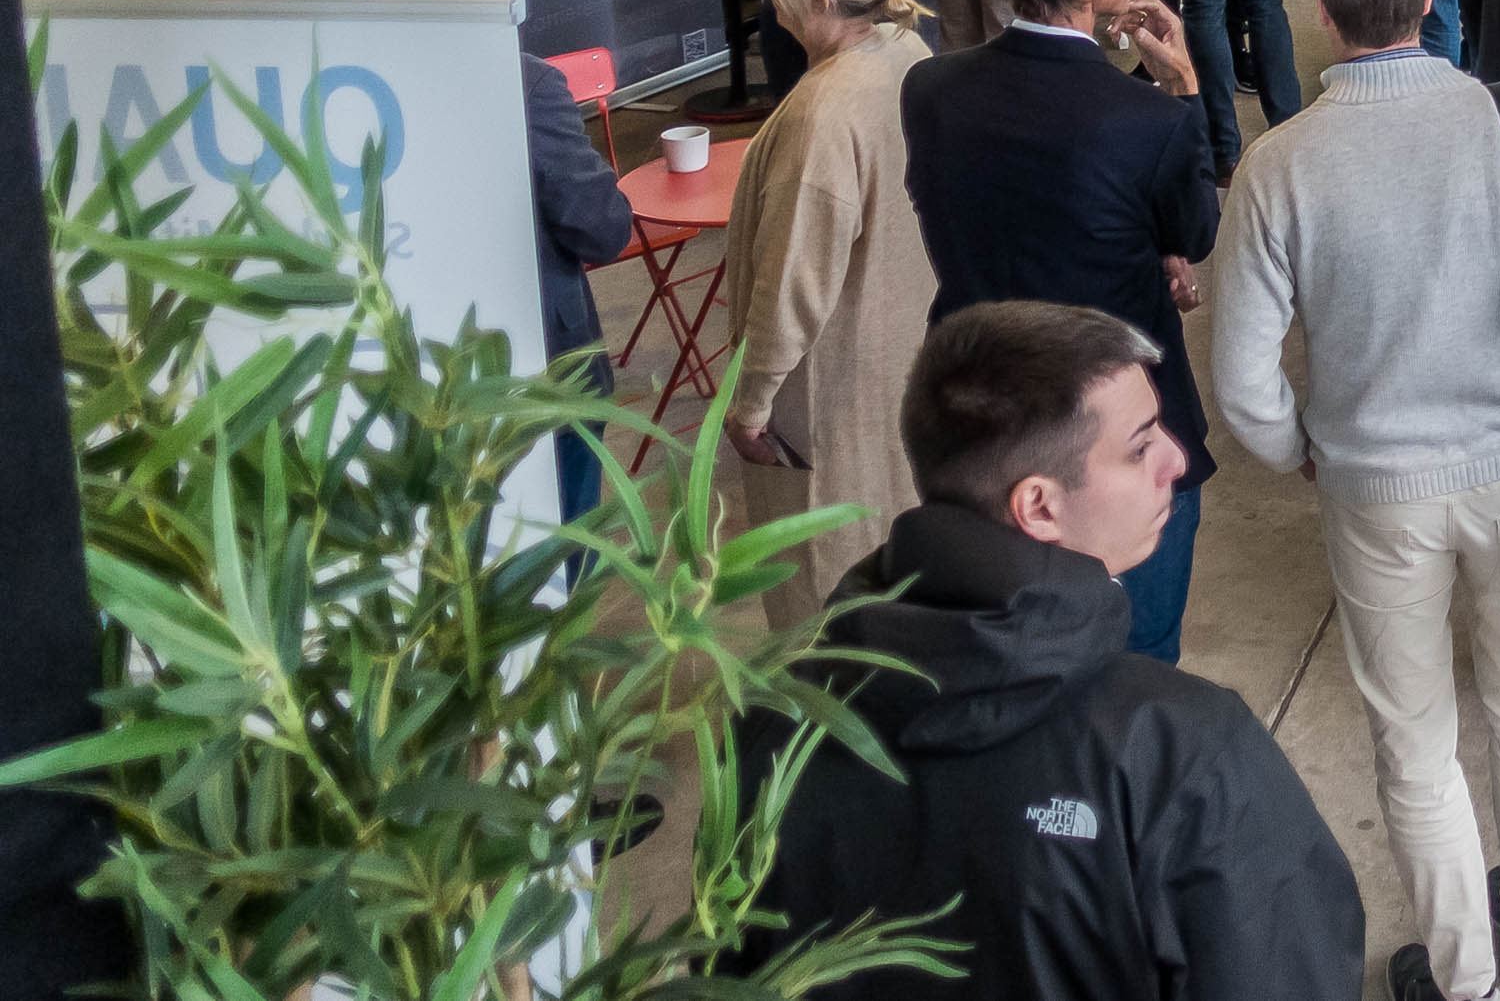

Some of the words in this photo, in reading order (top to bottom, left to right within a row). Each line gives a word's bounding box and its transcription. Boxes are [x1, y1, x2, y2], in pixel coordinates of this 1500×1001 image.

[1050, 798, 1077, 812] THE
[1026, 807, 1075, 827] NORTH
[1037, 821, 1073, 836] FACE
